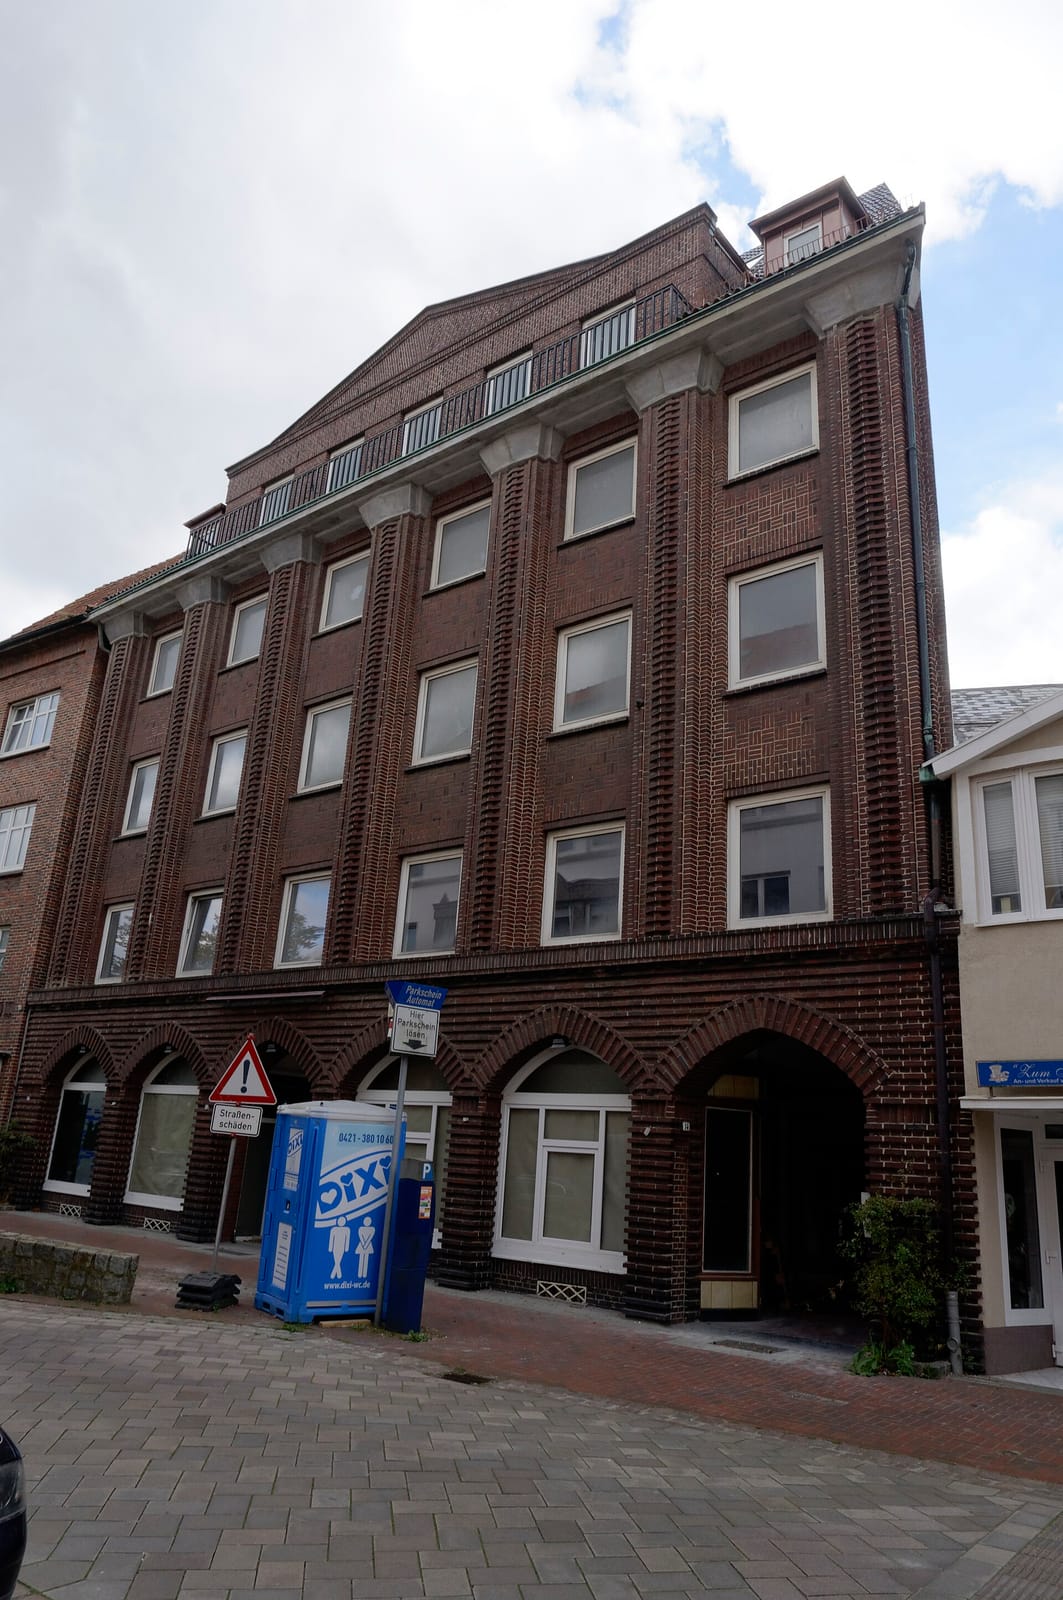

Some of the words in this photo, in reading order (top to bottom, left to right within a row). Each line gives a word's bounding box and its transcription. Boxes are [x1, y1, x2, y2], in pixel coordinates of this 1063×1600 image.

[405, 985, 442, 1000] Parkschein
[406, 996, 435, 1007] Automat
[409, 1010, 425, 1019] Hier
[397, 1018, 436, 1031] Parkschein
[406, 1029, 426, 1039] lösen
[219, 1109, 255, 1120] Straßen-
[219, 1120, 252, 1131] schäden
[338, 1133, 356, 1143] 0421
[361, 1134, 375, 1144] 380
[376, 1134, 385, 1144] 10
[422, 1163, 431, 1179] P
[323, 1281, 371, 1290] www.dixi-wc.de
